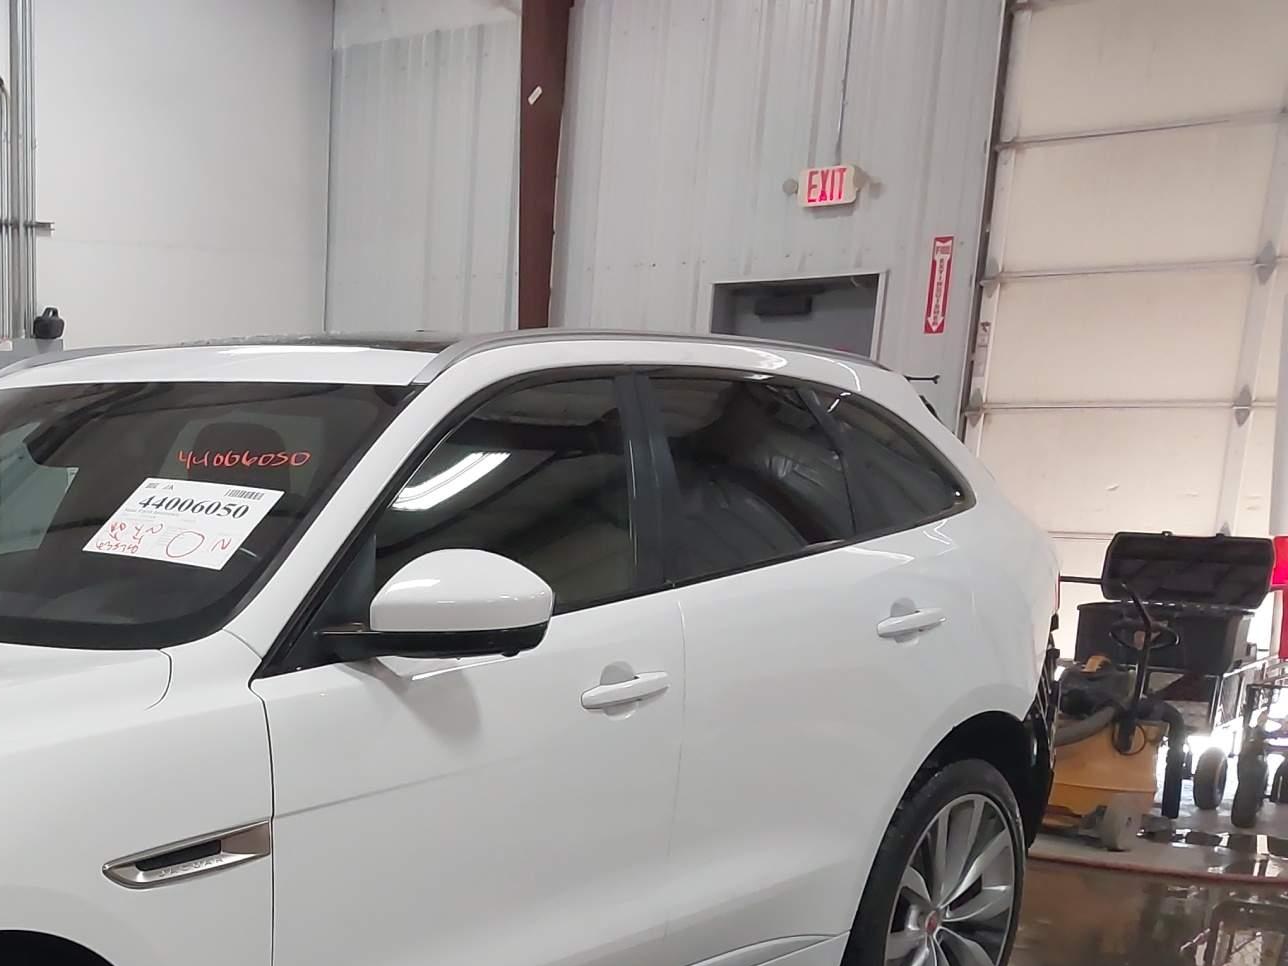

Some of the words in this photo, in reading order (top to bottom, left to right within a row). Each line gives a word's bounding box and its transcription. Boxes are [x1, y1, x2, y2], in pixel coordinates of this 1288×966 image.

[807, 167, 847, 203] EXIT
[177, 449, 311, 469] 44006050
[138, 495, 250, 520] 44006050
